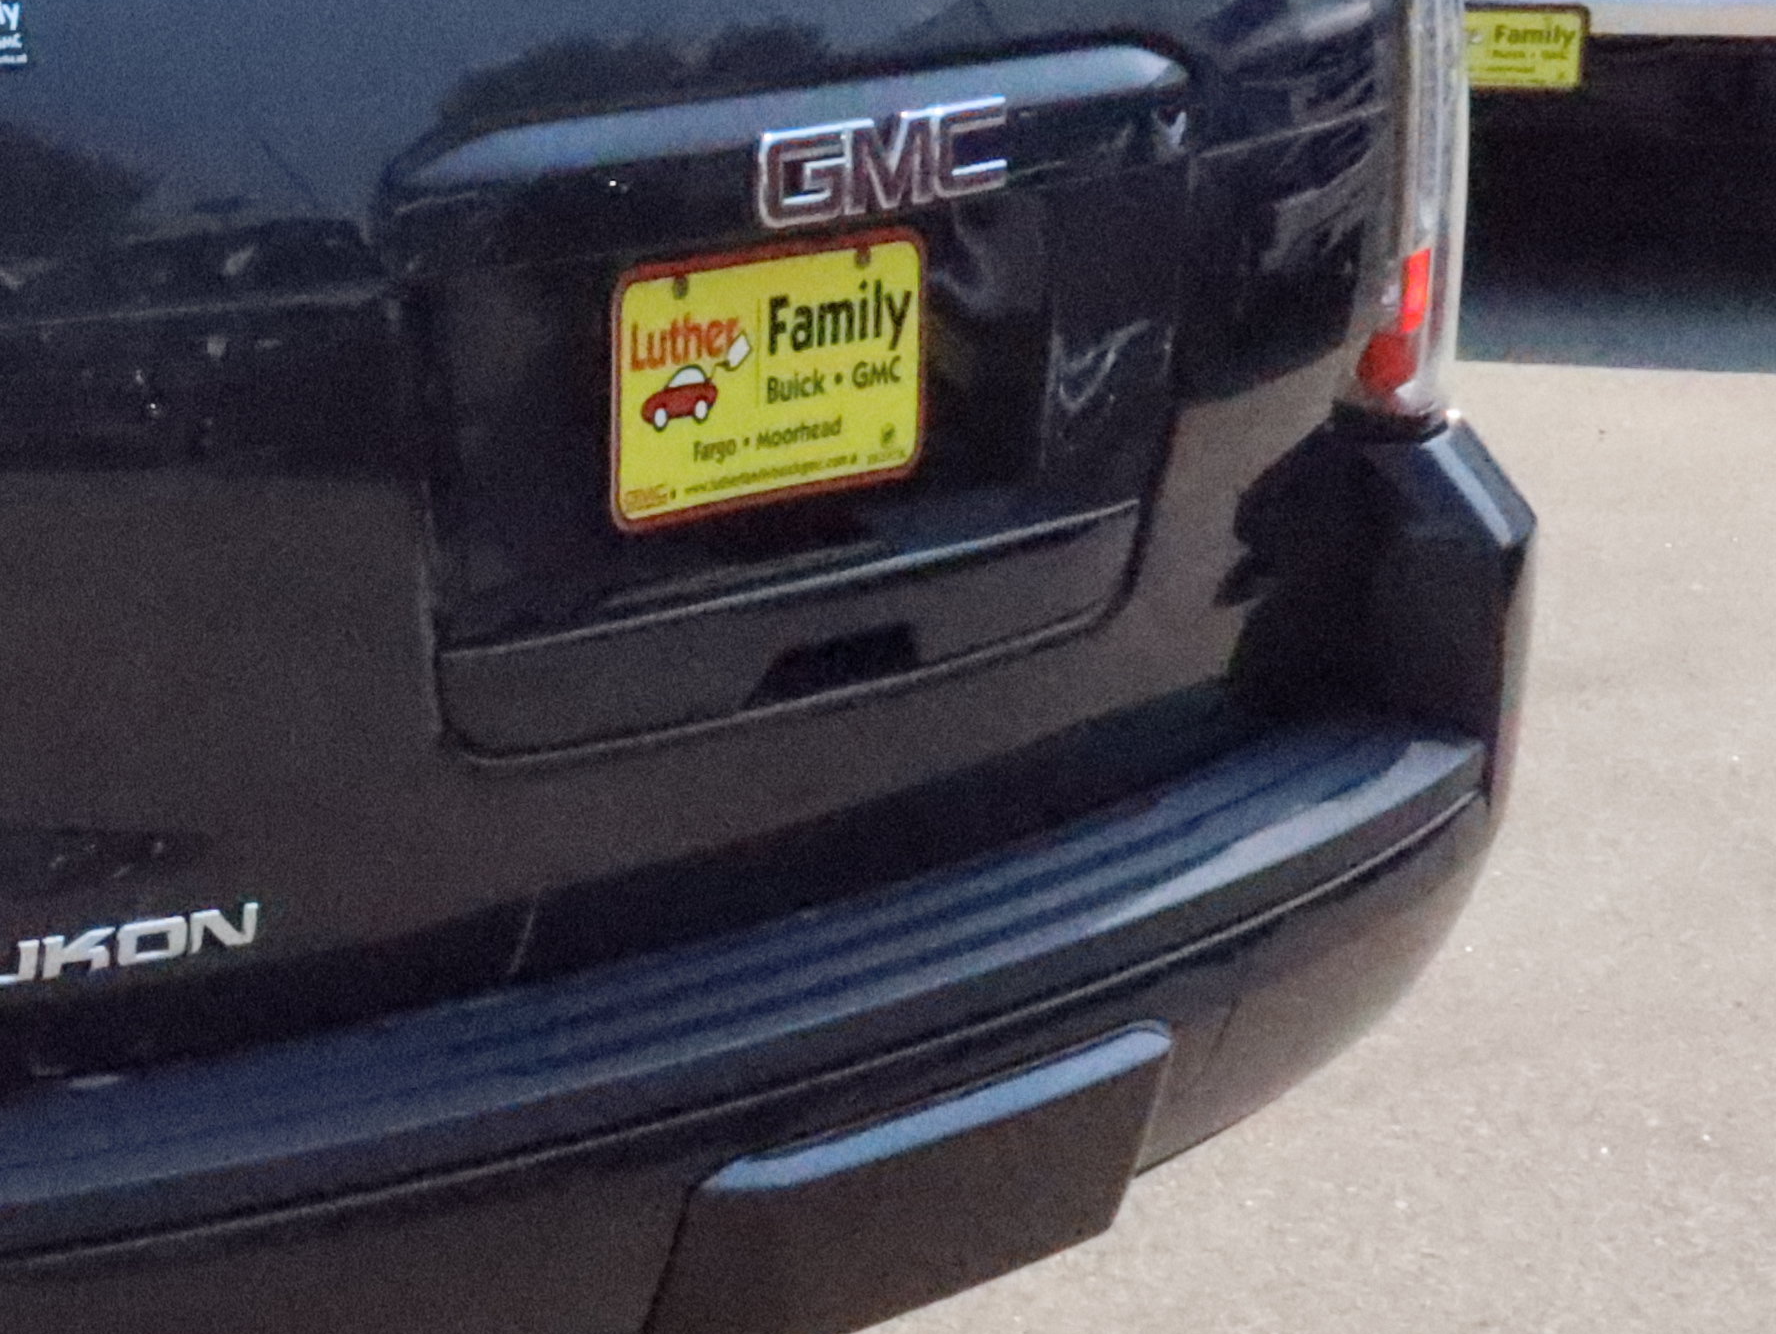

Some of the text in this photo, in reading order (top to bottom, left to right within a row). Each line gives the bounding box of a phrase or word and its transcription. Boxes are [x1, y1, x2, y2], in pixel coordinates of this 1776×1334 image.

[1493, 23, 1577, 49] Family
[758, 94, 1008, 229] GMC
[629, 313, 741, 372] Luther
[767, 277, 913, 357] Family
[766, 355, 902, 405] Buick GMC
[692, 414, 843, 465] Fargo Moorhead
